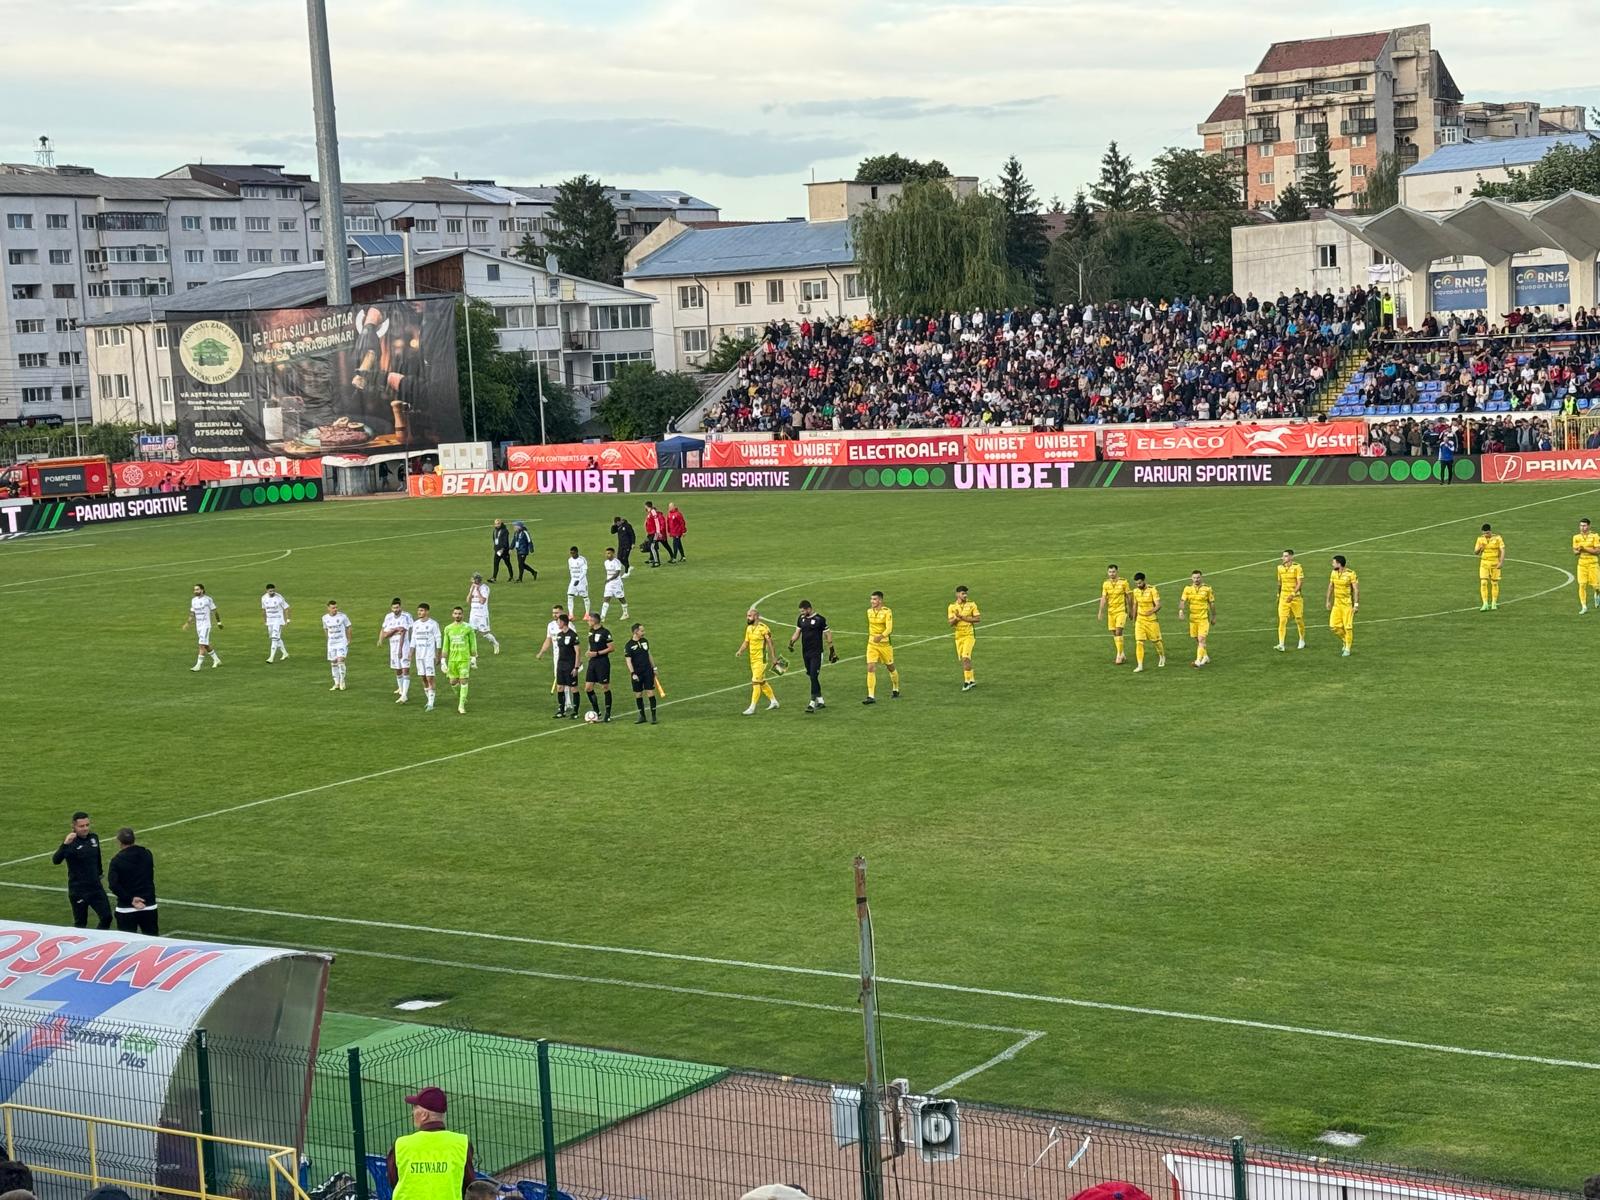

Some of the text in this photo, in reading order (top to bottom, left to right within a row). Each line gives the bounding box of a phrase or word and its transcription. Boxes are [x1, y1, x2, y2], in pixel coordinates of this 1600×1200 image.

[289, 323, 306, 339] SAU
[308, 320, 320, 335] LA
[321, 311, 353, 332] GRĂTAR
[740, 442, 841, 457] UNIBET UNIBET
[849, 440, 959, 460] ELECTROALFA
[974, 434, 1088, 451] UNIBET UNIBET
[1136, 436, 1225, 450] ELSACO
[224, 456, 293, 479] TAQT
[1134, 464, 1272, 482] PARIURI SPORTIVE
[1525, 458, 1600, 472] PRIMA
[44, 473, 82, 483] POMPIERII
[442, 472, 529, 493] BETANO
[537, 469, 635, 493] UNIBET
[682, 471, 790, 487] PARIURI SPORTIVE
[953, 462, 1075, 489] UNIBET
[75, 496, 188, 522] PARIURI SPORTIVE
[410, 1161, 448, 1174] STEWARD
